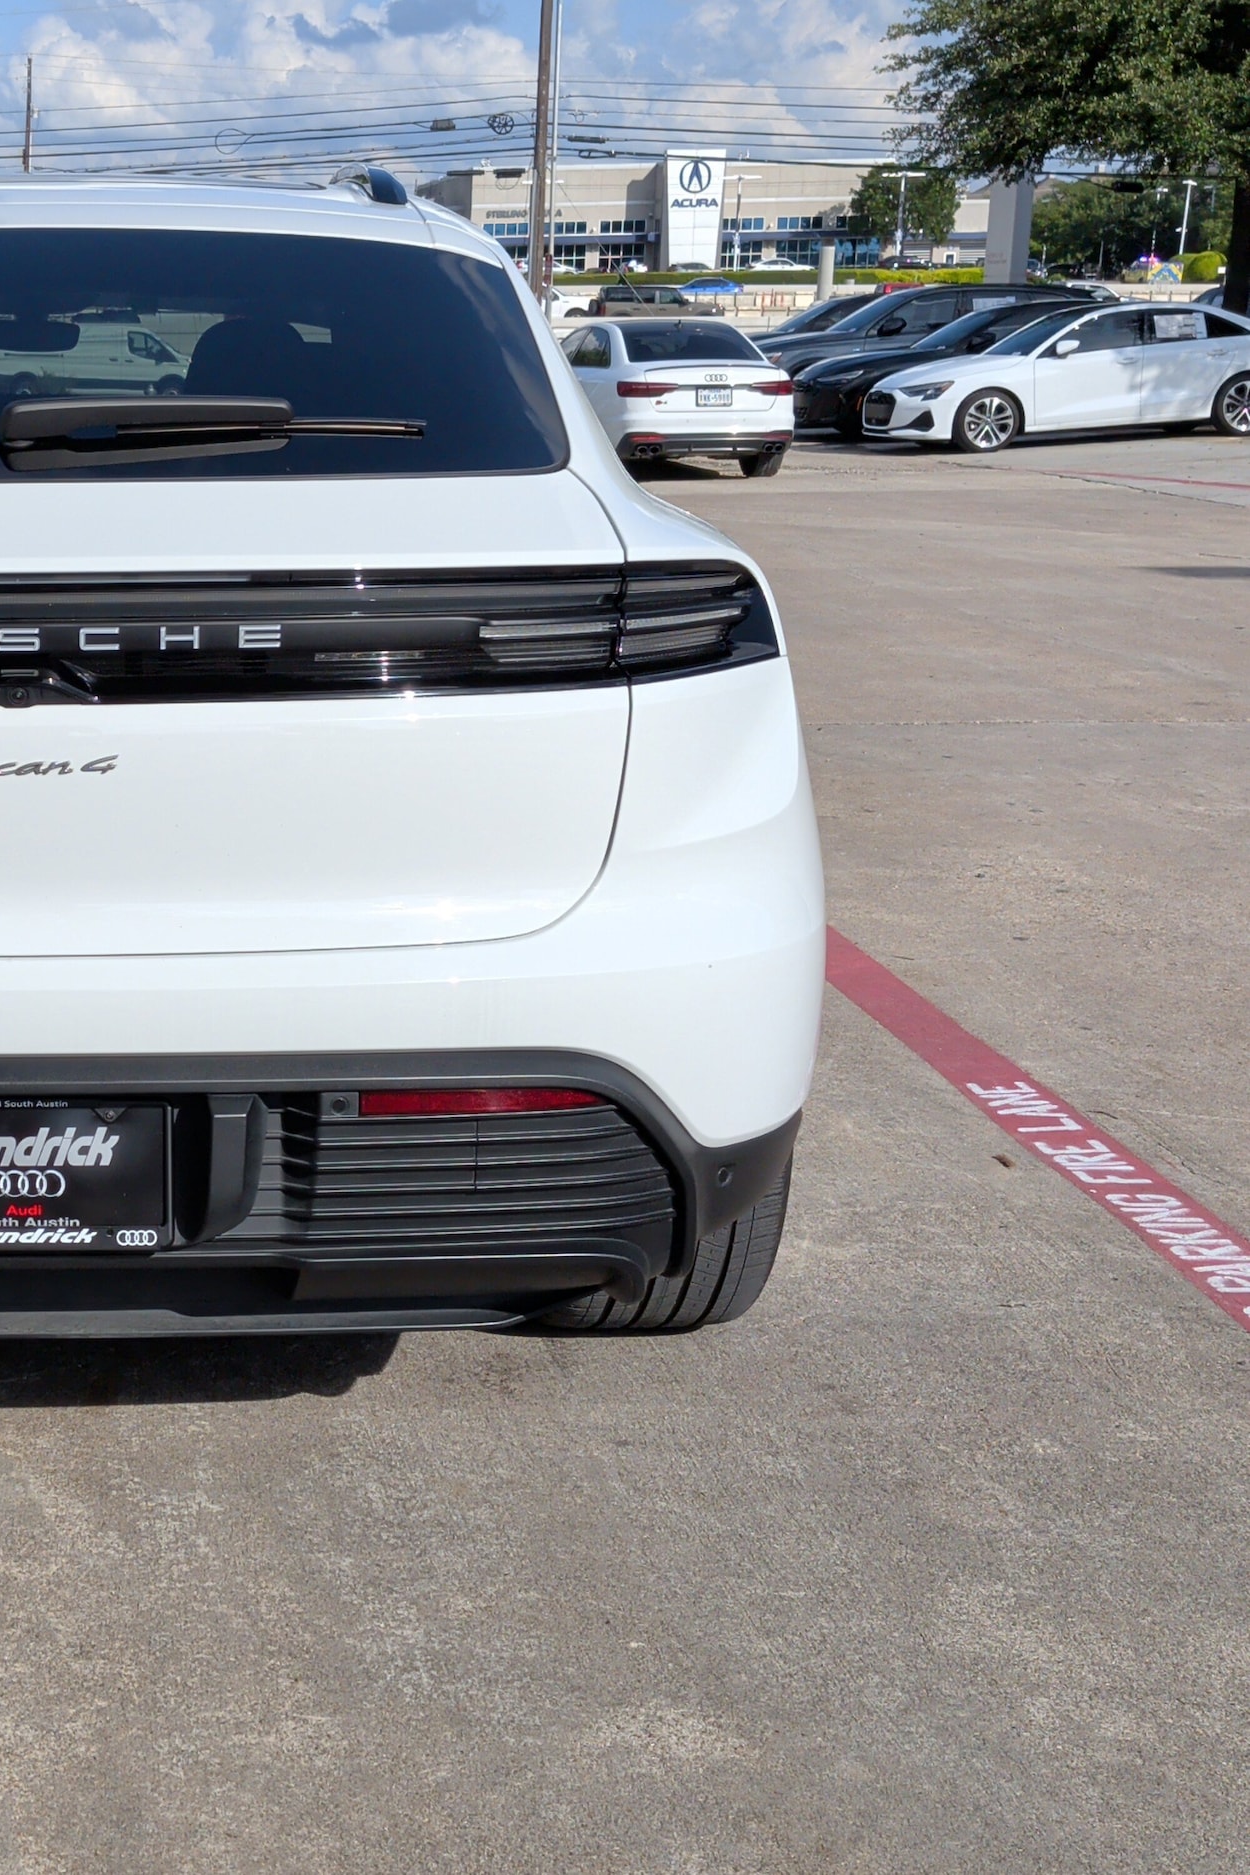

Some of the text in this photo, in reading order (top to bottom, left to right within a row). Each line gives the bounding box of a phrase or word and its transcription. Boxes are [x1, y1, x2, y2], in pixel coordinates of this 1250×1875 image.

[670, 198, 719, 208] ACURA
[79, 754, 118, 776] 4
[4, 1100, 33, 1108] South
[36, 1100, 68, 1108] Austin
[966, 1081, 1083, 1133] LANE
[1034, 1139, 1152, 1184] FIRE
[6, 1204, 42, 1216] Audi
[24, 1216, 80, 1228] Austin
